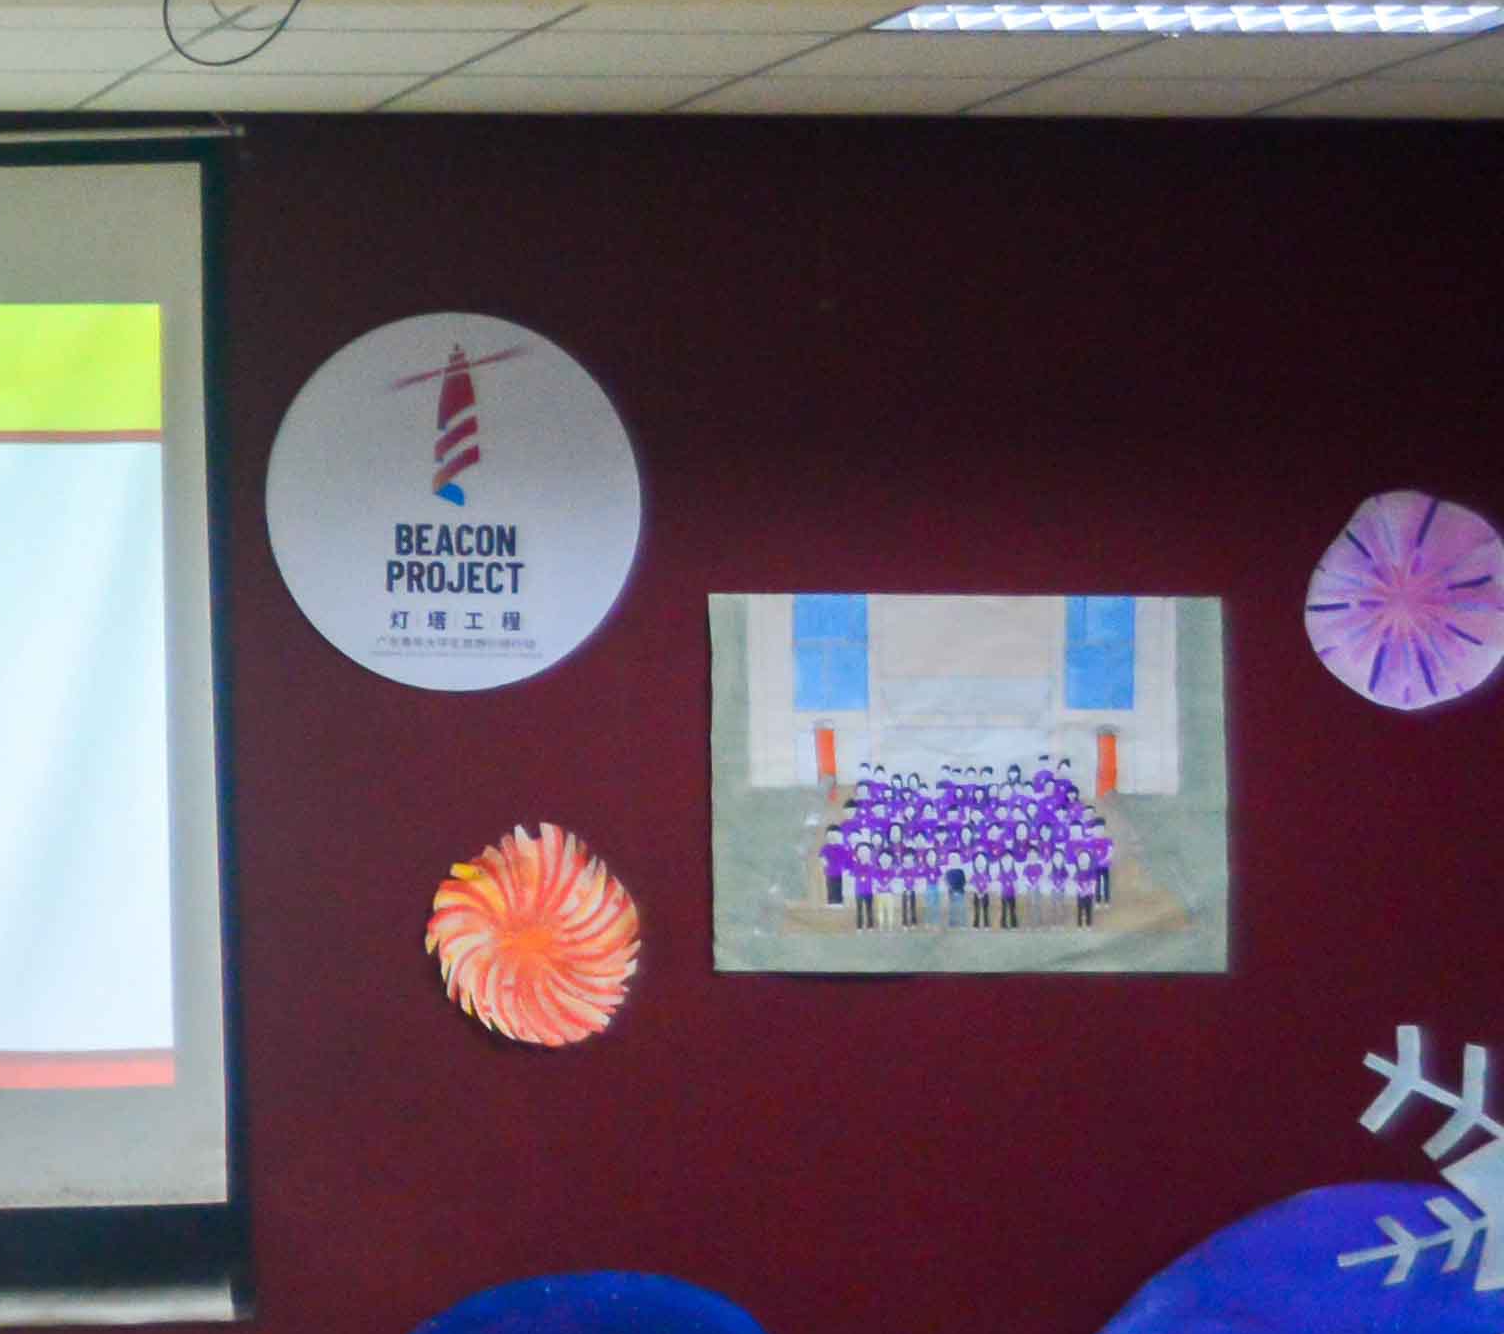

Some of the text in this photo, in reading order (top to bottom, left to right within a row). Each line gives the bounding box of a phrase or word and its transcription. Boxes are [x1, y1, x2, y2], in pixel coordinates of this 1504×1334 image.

[395, 523, 517, 558] BEACON
[386, 561, 525, 595] PROJECT
[389, 610, 522, 631] 灯塔工程
